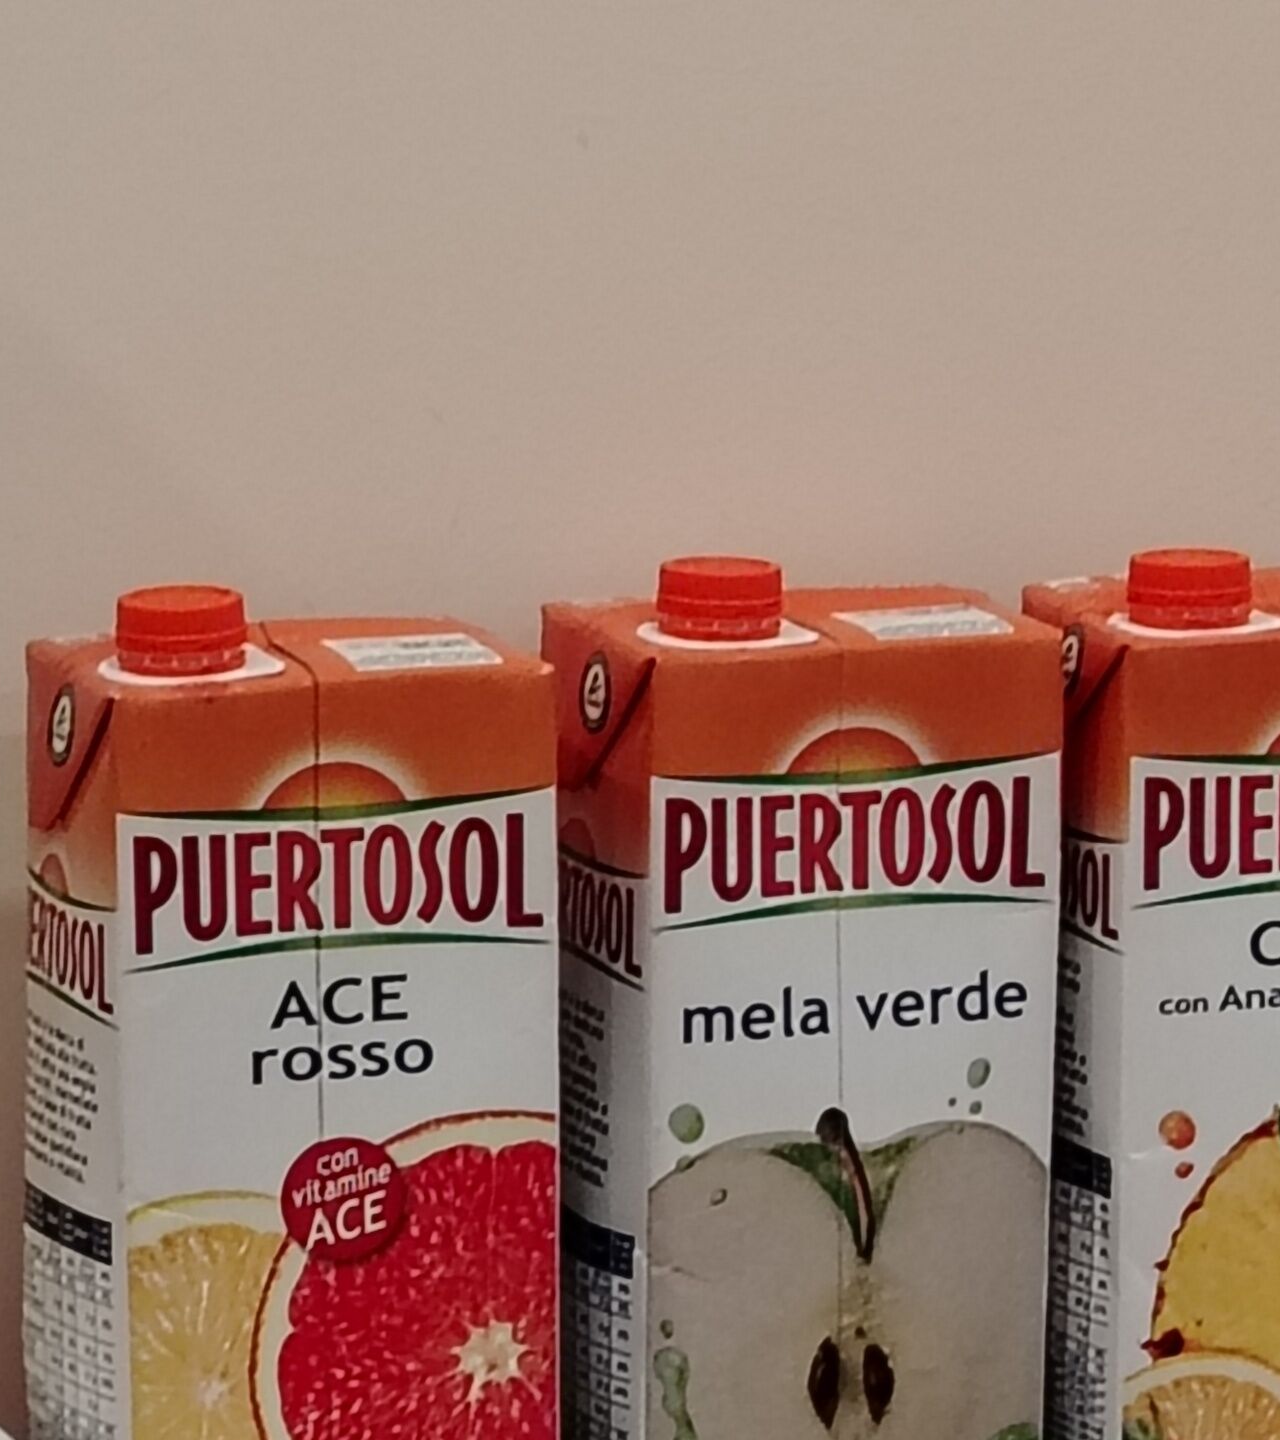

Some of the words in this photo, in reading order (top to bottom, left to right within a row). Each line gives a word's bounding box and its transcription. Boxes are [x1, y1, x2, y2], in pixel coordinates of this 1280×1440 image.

[663, 776, 1045, 914] PUERTOSOL
[132, 813, 544, 955] PUERTOSOL
[270, 973, 409, 1030] ACE
[682, 986, 830, 1044] mela
[856, 970, 1028, 1031] verde
[1158, 995, 1209, 1016] con
[252, 1038, 434, 1085] rosso
[292, 1162, 392, 1207] vitamine
[316, 1147, 359, 1177] con
[305, 1190, 387, 1252] ACE
